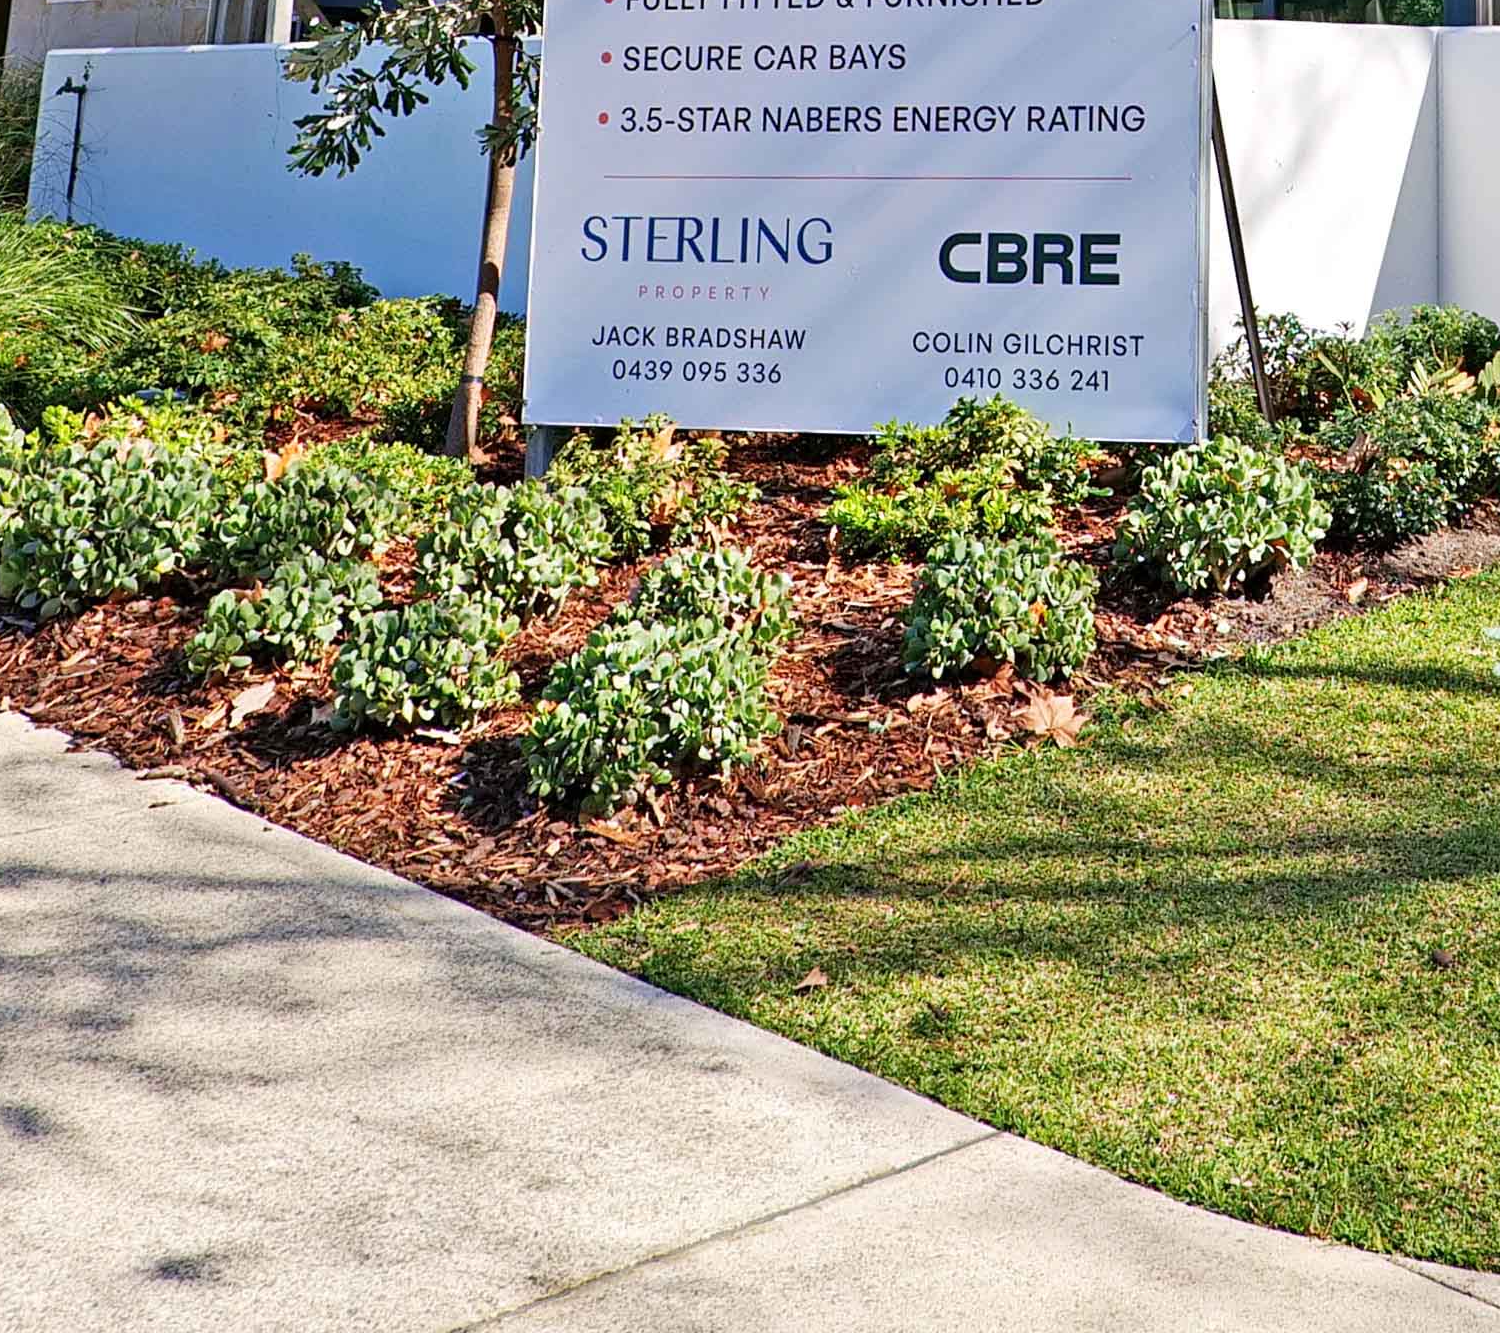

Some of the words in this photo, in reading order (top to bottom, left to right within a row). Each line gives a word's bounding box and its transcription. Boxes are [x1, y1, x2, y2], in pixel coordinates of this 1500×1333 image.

[623, 45, 743, 72] SECURE
[753, 44, 817, 71] CAR
[829, 43, 906, 70] BAYS
[620, 106, 752, 133] 3.5-STAR
[762, 105, 882, 133] NABERS
[893, 105, 1017, 133] ENERGY
[1027, 105, 1146, 133] RATING
[581, 215, 833, 265] STERLING
[938, 232, 1121, 286] CBRE
[638, 284, 769, 302] PROPERTY
[591, 325, 656, 347] JACK
[665, 326, 807, 350] BRADSHAW
[912, 331, 993, 354] COLIN
[1003, 332, 1145, 357] GILCHRIST
[612, 359, 673, 381] 0439
[682, 360, 727, 383] 095
[736, 362, 782, 384] 336
[944, 366, 1002, 390] 0410
[1012, 368, 1060, 391] 336
[1070, 369, 1109, 392] 241
